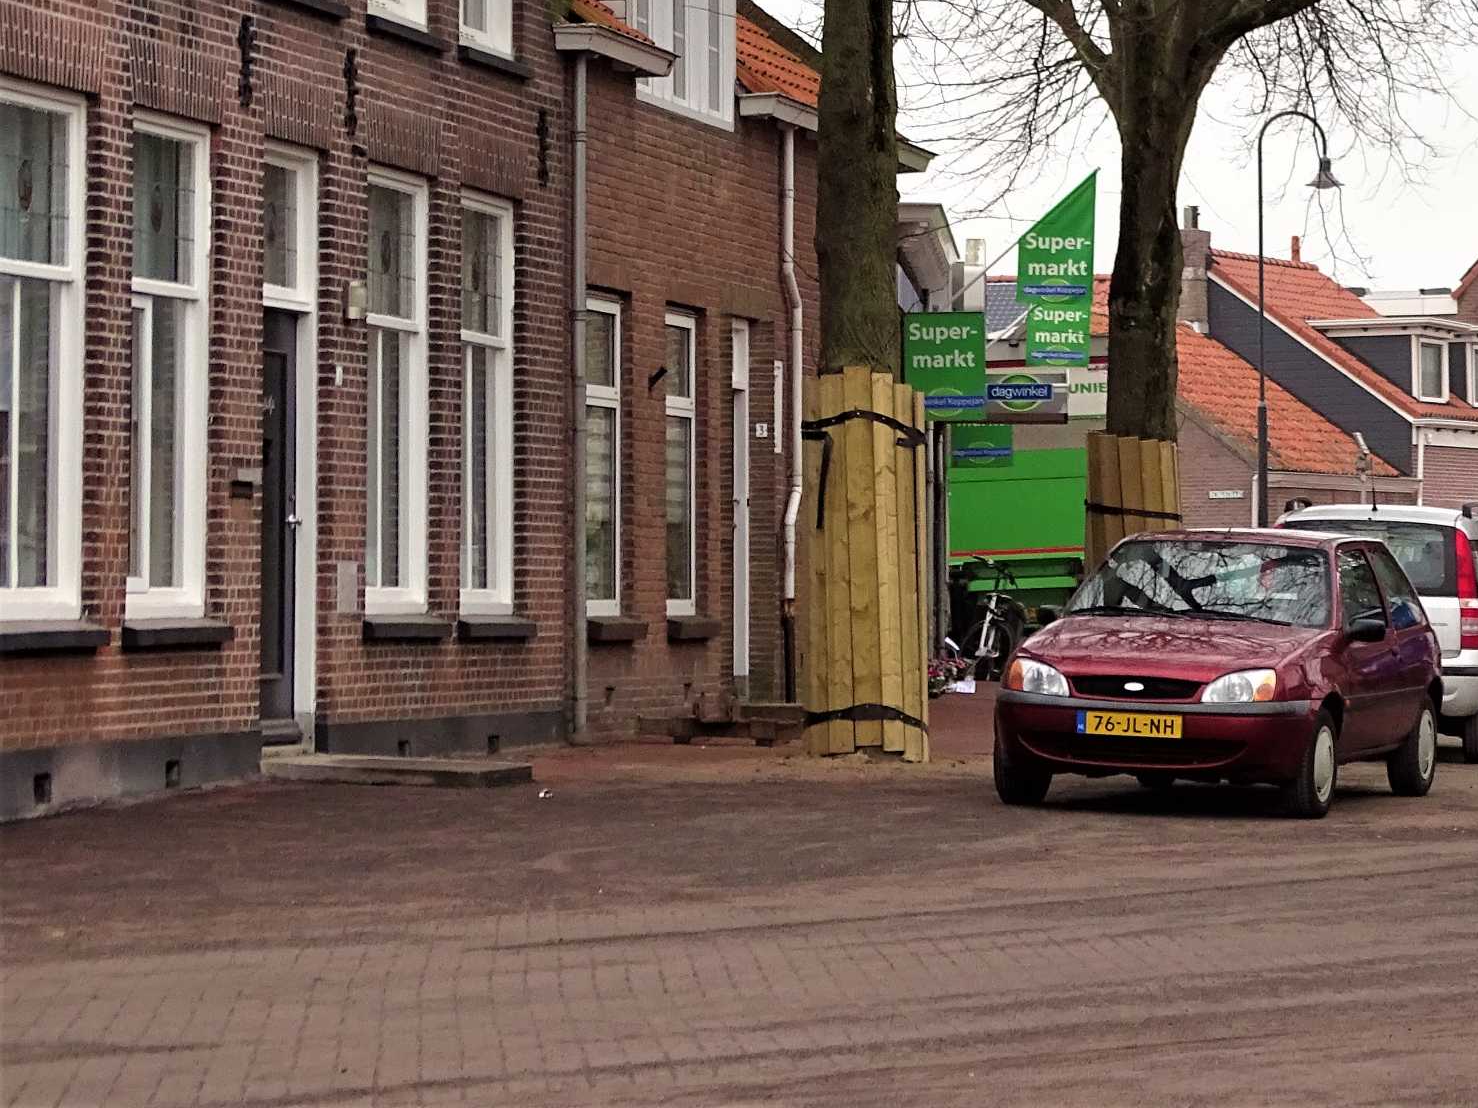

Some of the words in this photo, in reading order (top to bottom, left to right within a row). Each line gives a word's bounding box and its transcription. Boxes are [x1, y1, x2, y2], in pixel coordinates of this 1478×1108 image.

[1025, 232, 1091, 253] Super-
[1028, 258, 1088, 276] markt
[1033, 307, 1088, 324] Super-
[909, 323, 978, 344] Super-
[1035, 329, 1084, 344] markt
[912, 349, 976, 368] markt
[991, 386, 1048, 399] dagwinkel
[1093, 715, 1175, 735] 76-JL-NH
